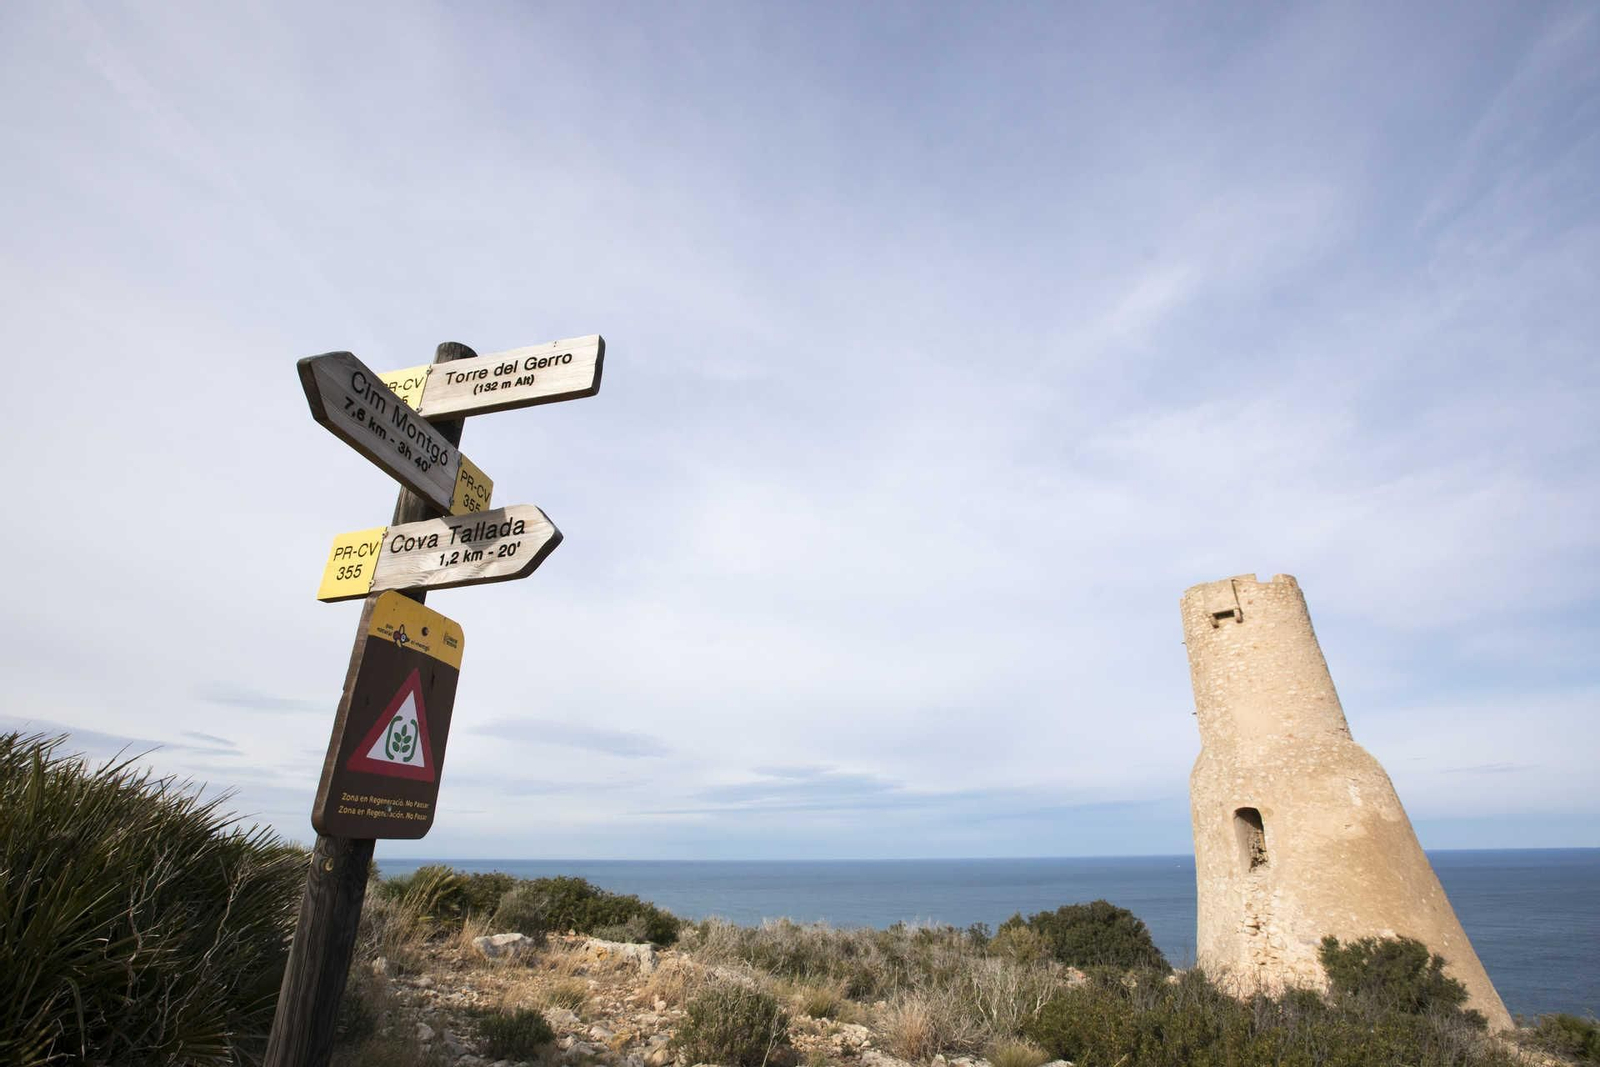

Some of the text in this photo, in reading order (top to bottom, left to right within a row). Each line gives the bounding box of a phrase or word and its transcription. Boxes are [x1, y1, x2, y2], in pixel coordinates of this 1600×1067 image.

[445, 350, 573, 385] Torre del Gerro
[384, 376, 424, 393] R-CV
[473, 374, 535, 396] (132 m Alt)
[351, 371, 448, 467] Cim Montgó
[342, 396, 365, 422] 7,6
[368, 415, 387, 440] km
[397, 441, 412, 461] 3h
[414, 455, 432, 473] 40'
[460, 470, 491, 503] PR-CV
[463, 493, 482, 513] 355
[390, 516, 526, 554] Cova Tallada
[333, 541, 379, 561] PR-CV
[438, 550, 460, 567] 1,2
[463, 545, 483, 562] km
[498, 540, 521, 558] 20'
[336, 564, 362, 581] 355
[341, 792, 359, 802] Zona
[359, 795, 368, 803] en
[405, 799, 413, 807] No
[338, 805, 356, 815] Zona
[357, 808, 366, 816] en
[405, 812, 414, 820] No
